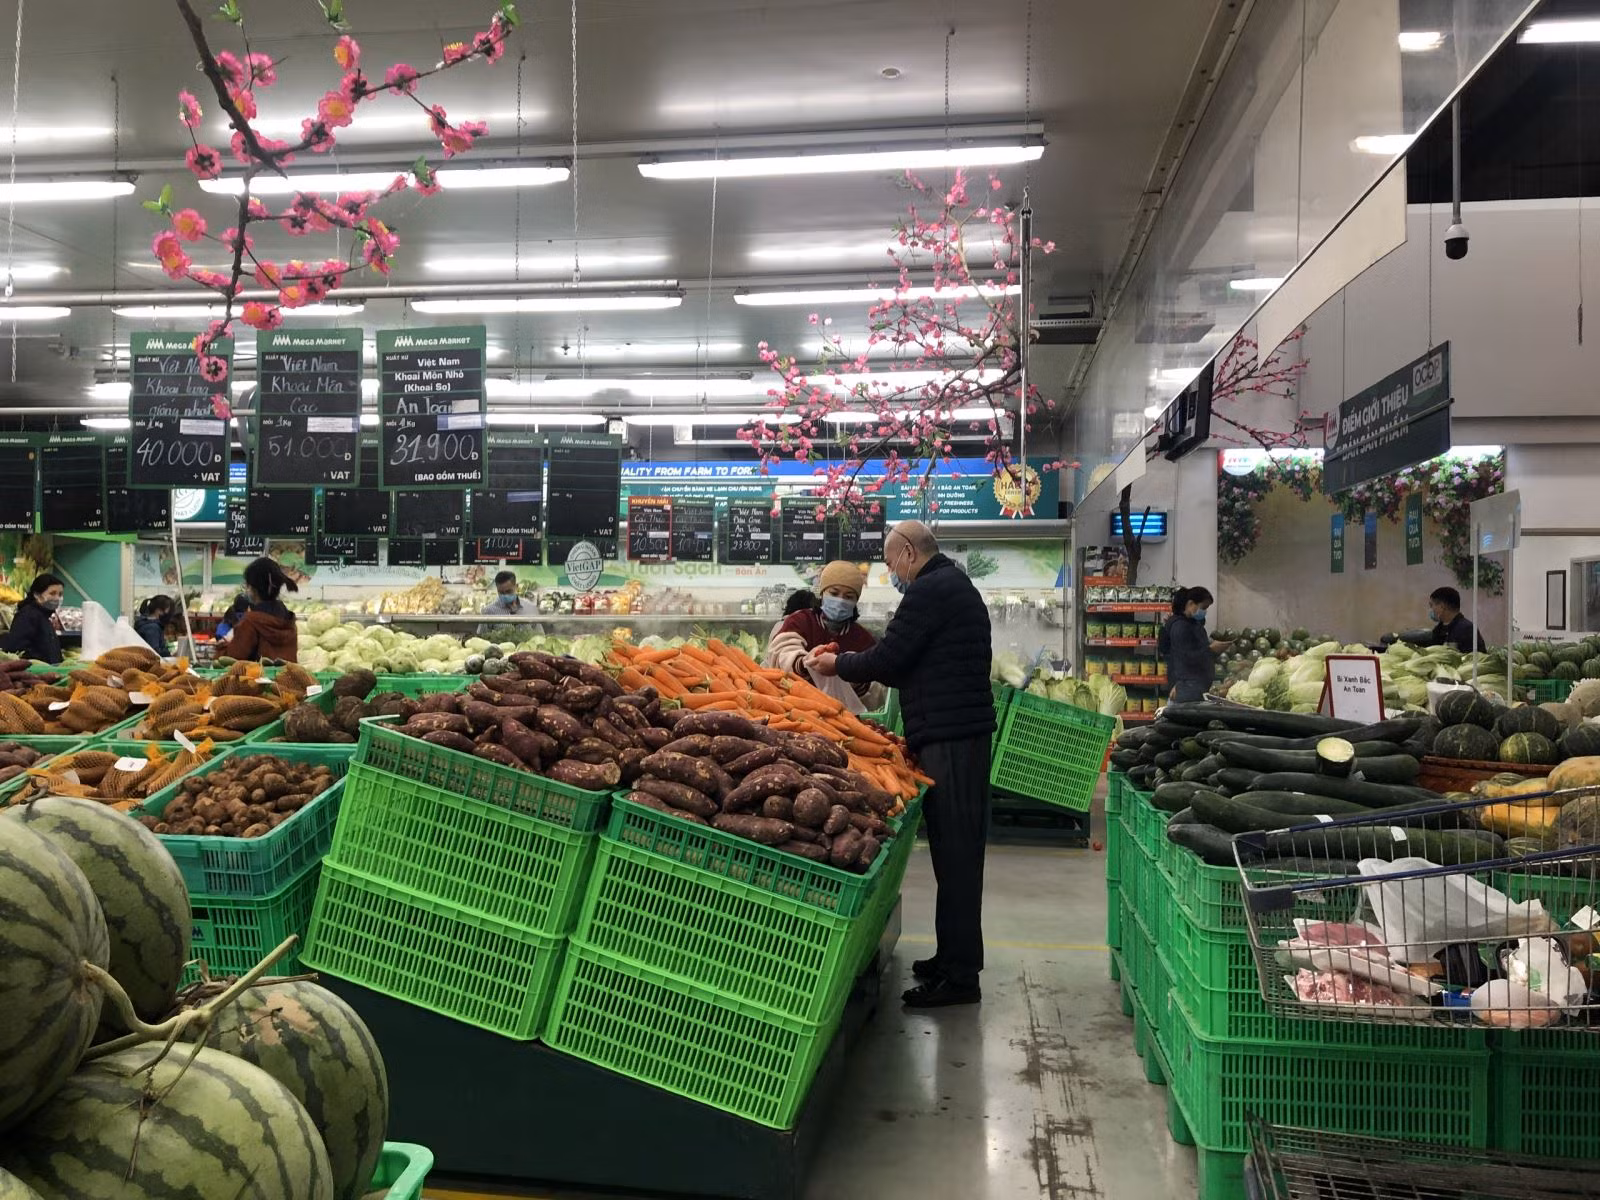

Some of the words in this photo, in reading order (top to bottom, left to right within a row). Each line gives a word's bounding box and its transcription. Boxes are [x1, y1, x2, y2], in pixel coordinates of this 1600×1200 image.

[310, 355, 340, 373] Nam
[417, 358, 437, 368] Việt
[438, 357, 460, 367] Nam
[394, 372, 421, 381] Khoai
[422, 371, 444, 380] Môn
[445, 369, 465, 379] Nhỏ
[271, 375, 310, 393] Khoai
[404, 383, 434, 393] (Khoai
[289, 397, 319, 415] Cao
[396, 397, 419, 414] An
[406, 420, 416, 428] Kg
[389, 433, 475, 466] 31.900
[330, 470, 351, 480] VAT
[414, 473, 435, 482] (BAO
[456, 469, 481, 480] THUẾ)
[620, 467, 652, 476] ALITY
[654, 467, 682, 476] FROM
[683, 467, 712, 476] FARM
[715, 467, 726, 475] TO
[201, 472, 221, 482] VAT
[372, 525, 387, 533] VAT
[446, 526, 460, 534] VAT
[598, 528, 613, 536] VAT
[566, 560, 601, 573] VietGAP
[1344, 675, 1359, 683] Xanh
